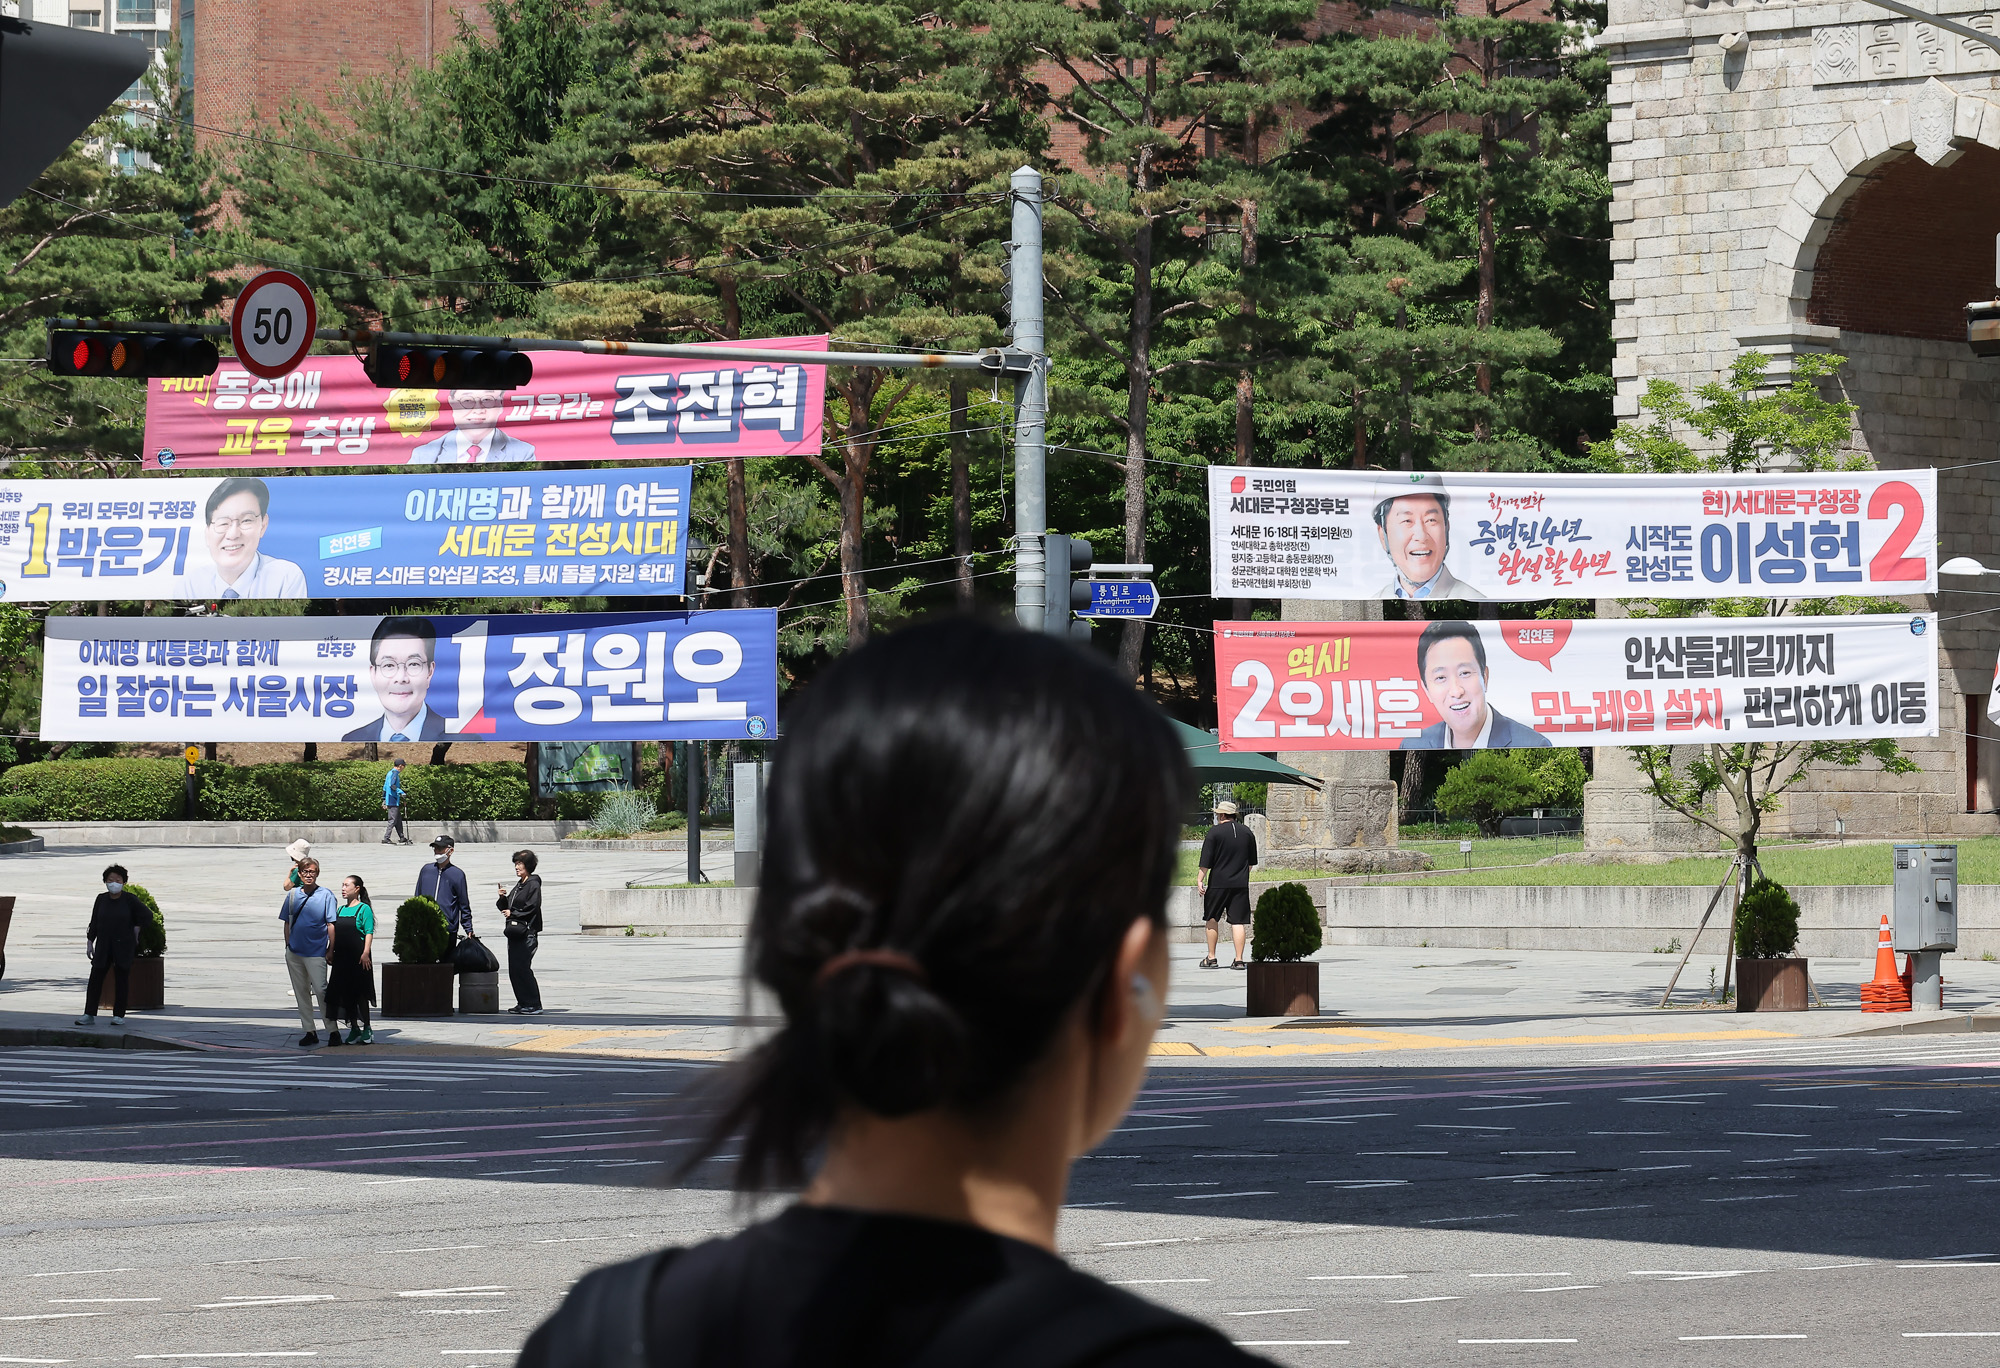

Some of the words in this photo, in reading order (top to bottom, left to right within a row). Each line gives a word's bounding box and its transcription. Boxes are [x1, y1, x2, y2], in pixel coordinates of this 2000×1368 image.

[253, 307, 292, 345] 50
[213, 370, 322, 410] 동성애
[504, 392, 605, 423] 교육감은
[611, 364, 807, 442] 조전혁
[218, 416, 293, 456] 교육
[300, 416, 375, 456] 추방
[404, 487, 533, 522] 이재명과
[541, 484, 605, 520] 함께
[615, 482, 680, 518] 여는
[1252, 479, 1297, 493] 국민의힘
[1520, 491, 1546, 512] 변화
[62, 502, 92, 520] 우리
[97, 502, 144, 520] 모두의
[149, 501, 197, 520] 구청장
[1230, 497, 1350, 515] 서대문구청장후보
[21, 503, 52, 578] 1
[329, 532, 372, 555] 천연동
[438, 525, 535, 558] 서대문
[546, 520, 678, 557] 전성시대
[1230, 525, 1261, 539] 서대문
[1300, 526, 1353, 540] 국회의원(전)
[1231, 540, 1268, 552] 연세대학교
[1469, 517, 1542, 556] 증명된
[1540, 517, 1592, 546] 4년
[1625, 525, 1693, 552] 시작도
[1867, 480, 1928, 582] 2
[57, 526, 191, 578] 박운기
[1231, 565, 1275, 577] 성균관대학교
[1276, 566, 1299, 577] 대학원
[1300, 566, 1321, 577] 언론학
[1322, 566, 1338, 577] 박사
[1286, 553, 1334, 565] 총동문회장(전)
[1498, 547, 1573, 586] 완성할
[1570, 548, 1618, 579] 4년
[1625, 555, 1693, 583] 완성도
[1699, 519, 1863, 585] 이성헌
[323, 567, 372, 587] 경사로
[375, 567, 425, 587] 스마트
[428, 566, 479, 586] 안심길
[482, 565, 519, 587] 조성,
[523, 565, 558, 585] 틈새
[561, 564, 597, 585] 돌봄
[601, 564, 635, 585] 지원
[638, 563, 675, 584] 확대
[1098, 584, 1130, 597] 통일로
[1231, 577, 1275, 589] 한국애견협회
[1277, 578, 1312, 590] 부회장(현)
[1137, 594, 1151, 604] 219
[78, 639, 139, 666] 이재명
[146, 639, 230, 666] 대통령과
[236, 638, 280, 666] 함께
[316, 642, 357, 658] 민주당
[1517, 629, 1555, 645] 천연동
[1287, 637, 1351, 679] 역시!
[1624, 633, 1836, 680] 안산둘레길까지
[77, 675, 108, 718] 일
[115, 675, 217, 718] 잘하는
[222, 674, 359, 718] 서울시장
[444, 620, 496, 734] 1
[507, 630, 748, 726] 정원오
[1231, 659, 1276, 739] 2
[1277, 677, 1423, 739] 오세훈
[1531, 688, 1655, 733] 모노레일
[1664, 687, 1731, 732] 설치,
[1743, 683, 1862, 728] 편리하게
[1871, 681, 1927, 725] 이동
